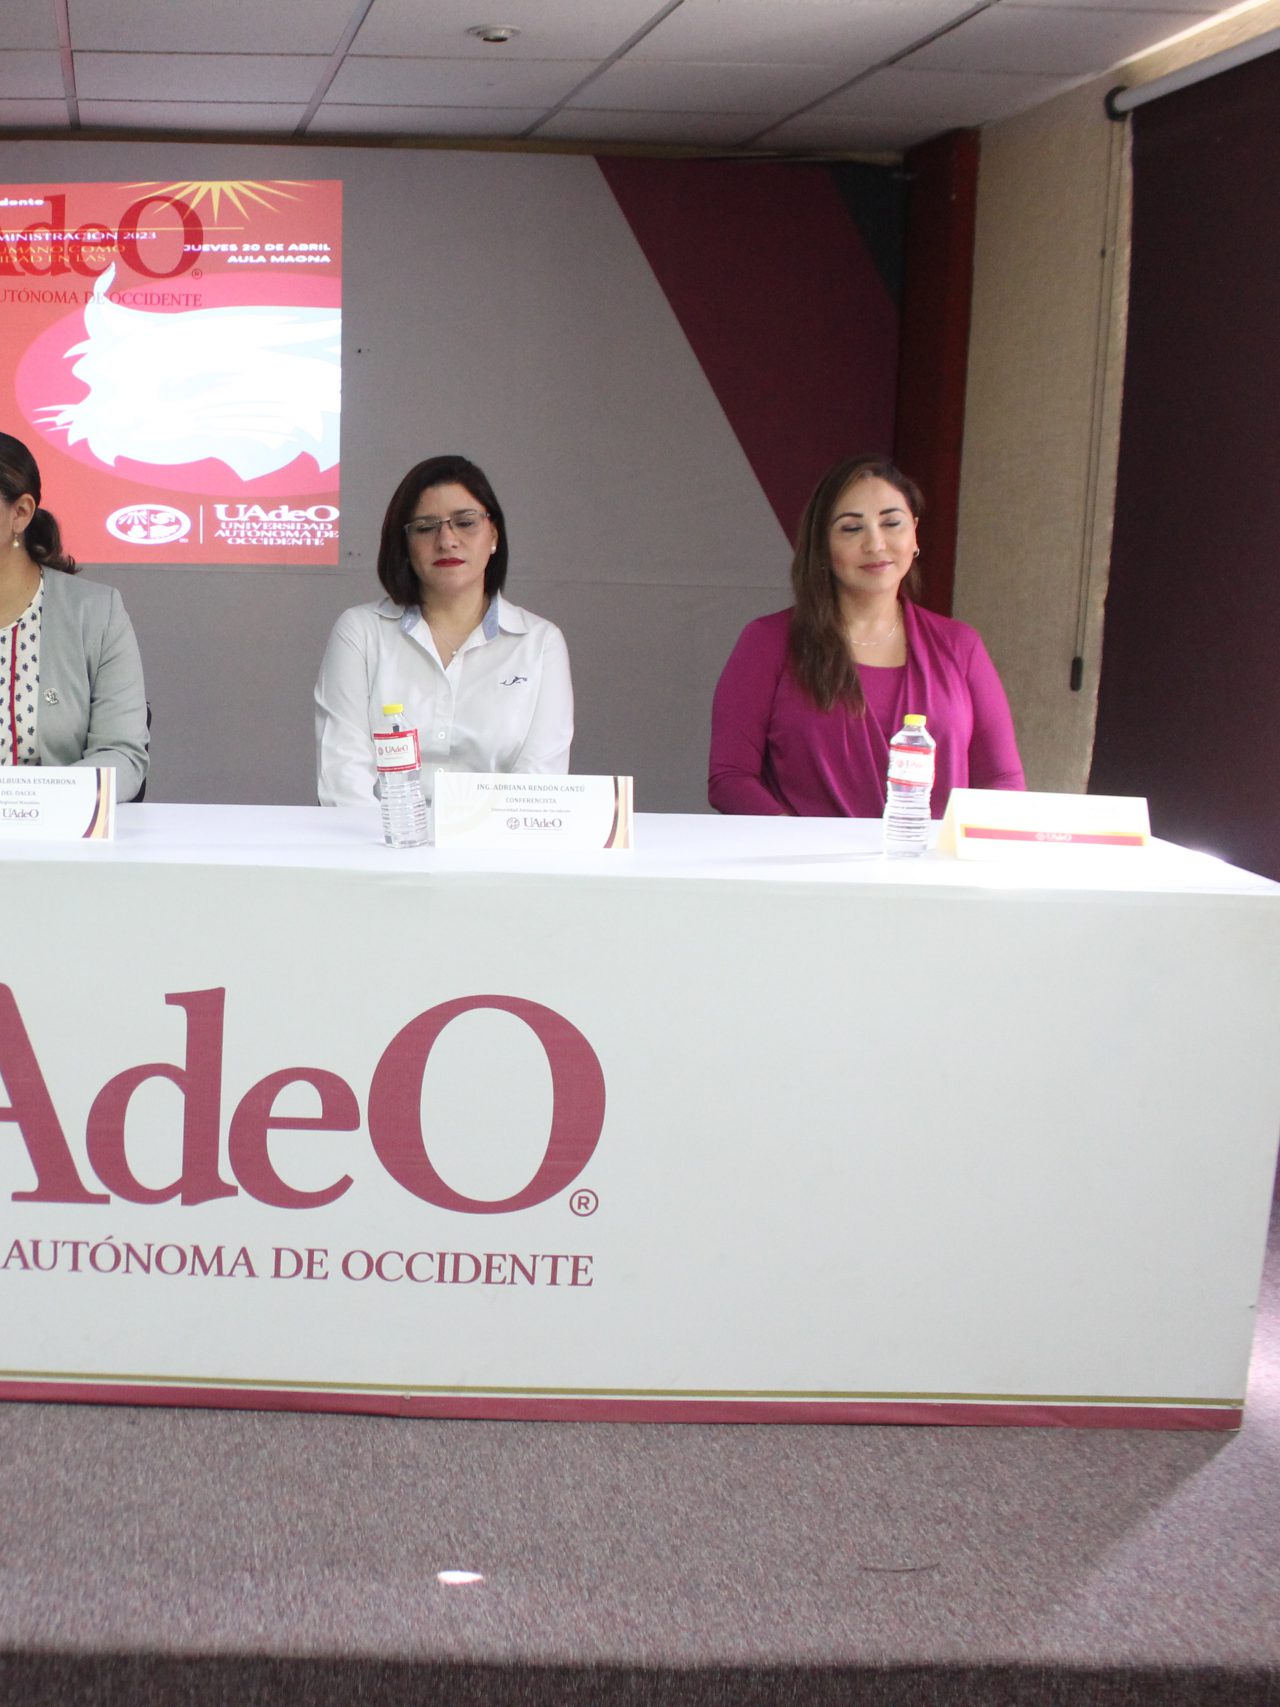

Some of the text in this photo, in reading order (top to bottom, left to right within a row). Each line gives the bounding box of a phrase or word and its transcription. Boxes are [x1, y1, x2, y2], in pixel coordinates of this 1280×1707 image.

[122, 231, 158, 240] 2023
[182, 243, 332, 252] JUEVES 20 DE ABRIL
[227, 255, 332, 264] AULA MAGNA
[111, 292, 203, 307] OCCIDENTE
[214, 504, 340, 522] UAdeO
[220, 522, 333, 530] UNIVERSIDAD
[316, 530, 340, 539] DE
[227, 537, 326, 546] OCCIDENTE
[2, 807, 40, 819] UAdeO
[523, 817, 562, 828] UAdeO
[0, 1234, 260, 1279] AUTÓNOMA
[270, 1246, 329, 1280] DE
[341, 1248, 595, 1288] OCCIDENTE
